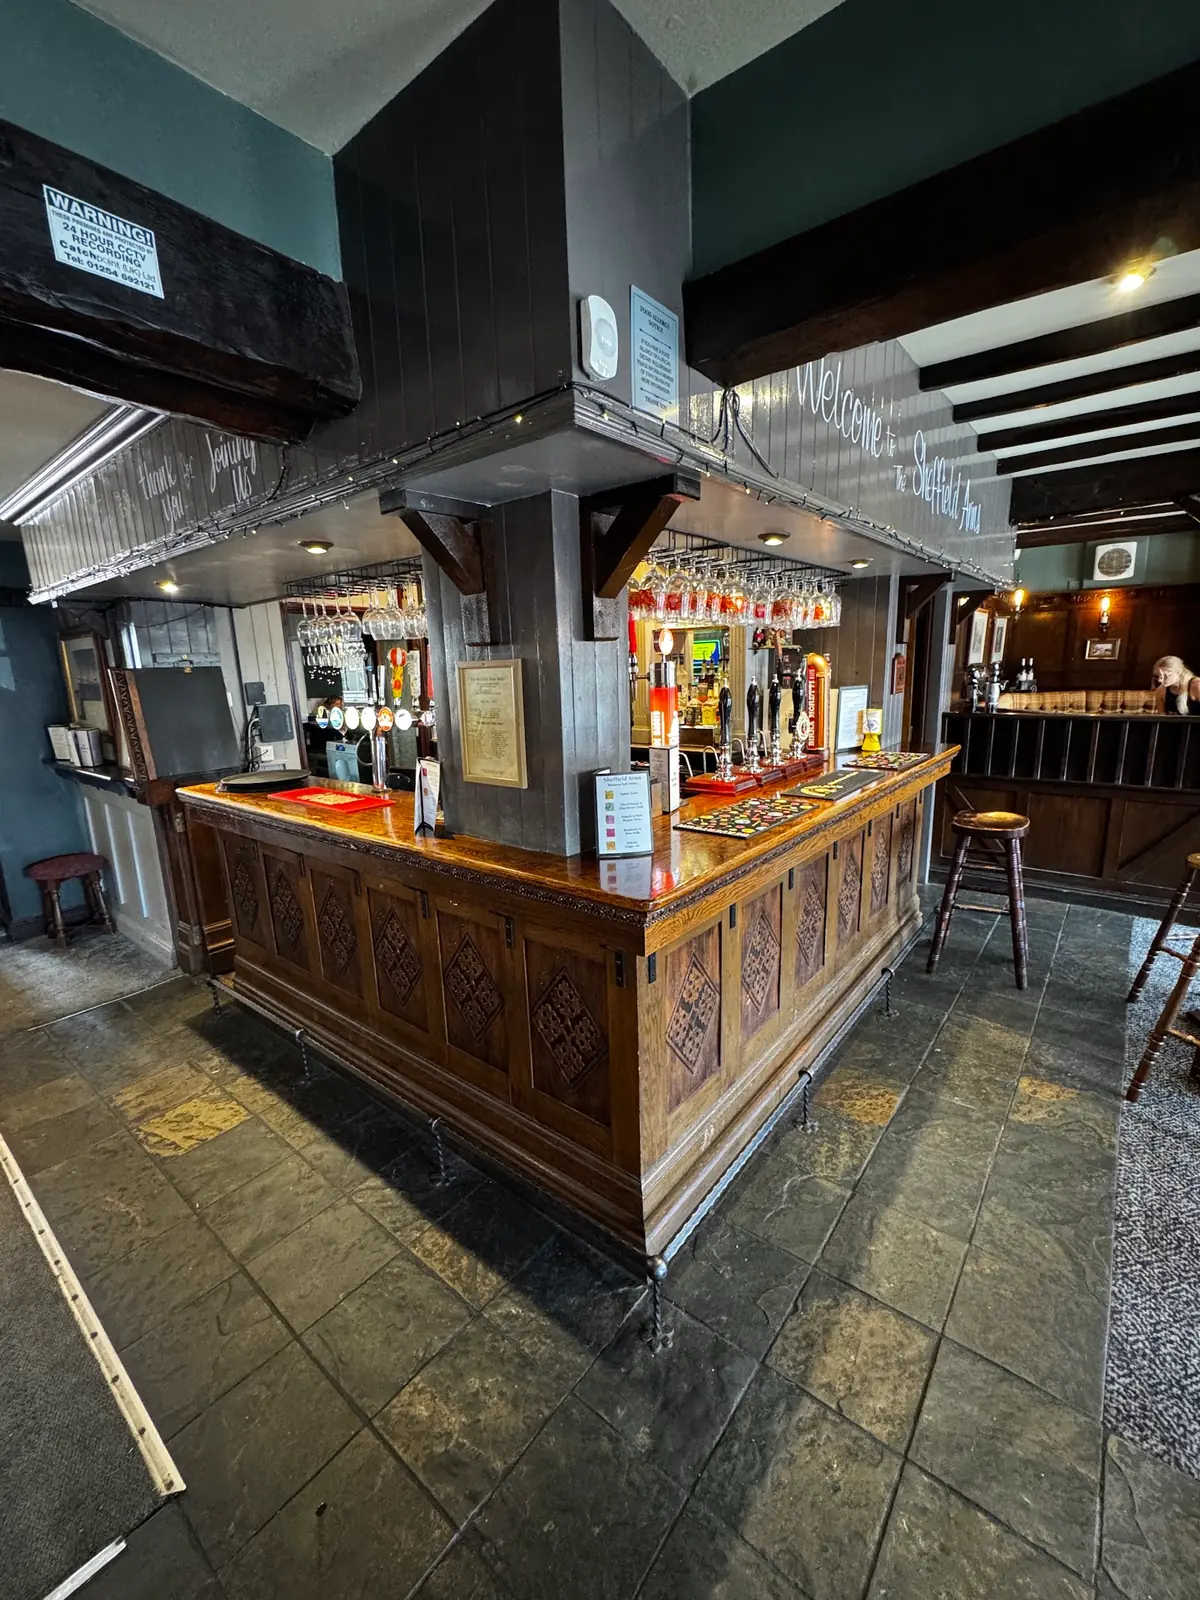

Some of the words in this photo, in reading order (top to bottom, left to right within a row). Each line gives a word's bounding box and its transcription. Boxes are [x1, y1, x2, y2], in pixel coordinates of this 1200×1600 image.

[49, 191, 152, 246] WARNING!
[60, 240, 120, 270] Catchpoint
[123, 264, 141, 279] (UK)
[142, 271, 156, 283] Ltd
[63, 223, 77, 234] 24
[81, 229, 115, 249] HOUR
[118, 244, 146, 262] CCTV
[72, 235, 142, 268] RECORDING
[65, 252, 84, 266] Tel:
[87, 261, 118, 278] 01254
[122, 273, 155, 291] 692121
[797, 358, 883, 458] Welcome
[913, 429, 961, 520] Sheffield
[959, 479, 981, 534] Arms
